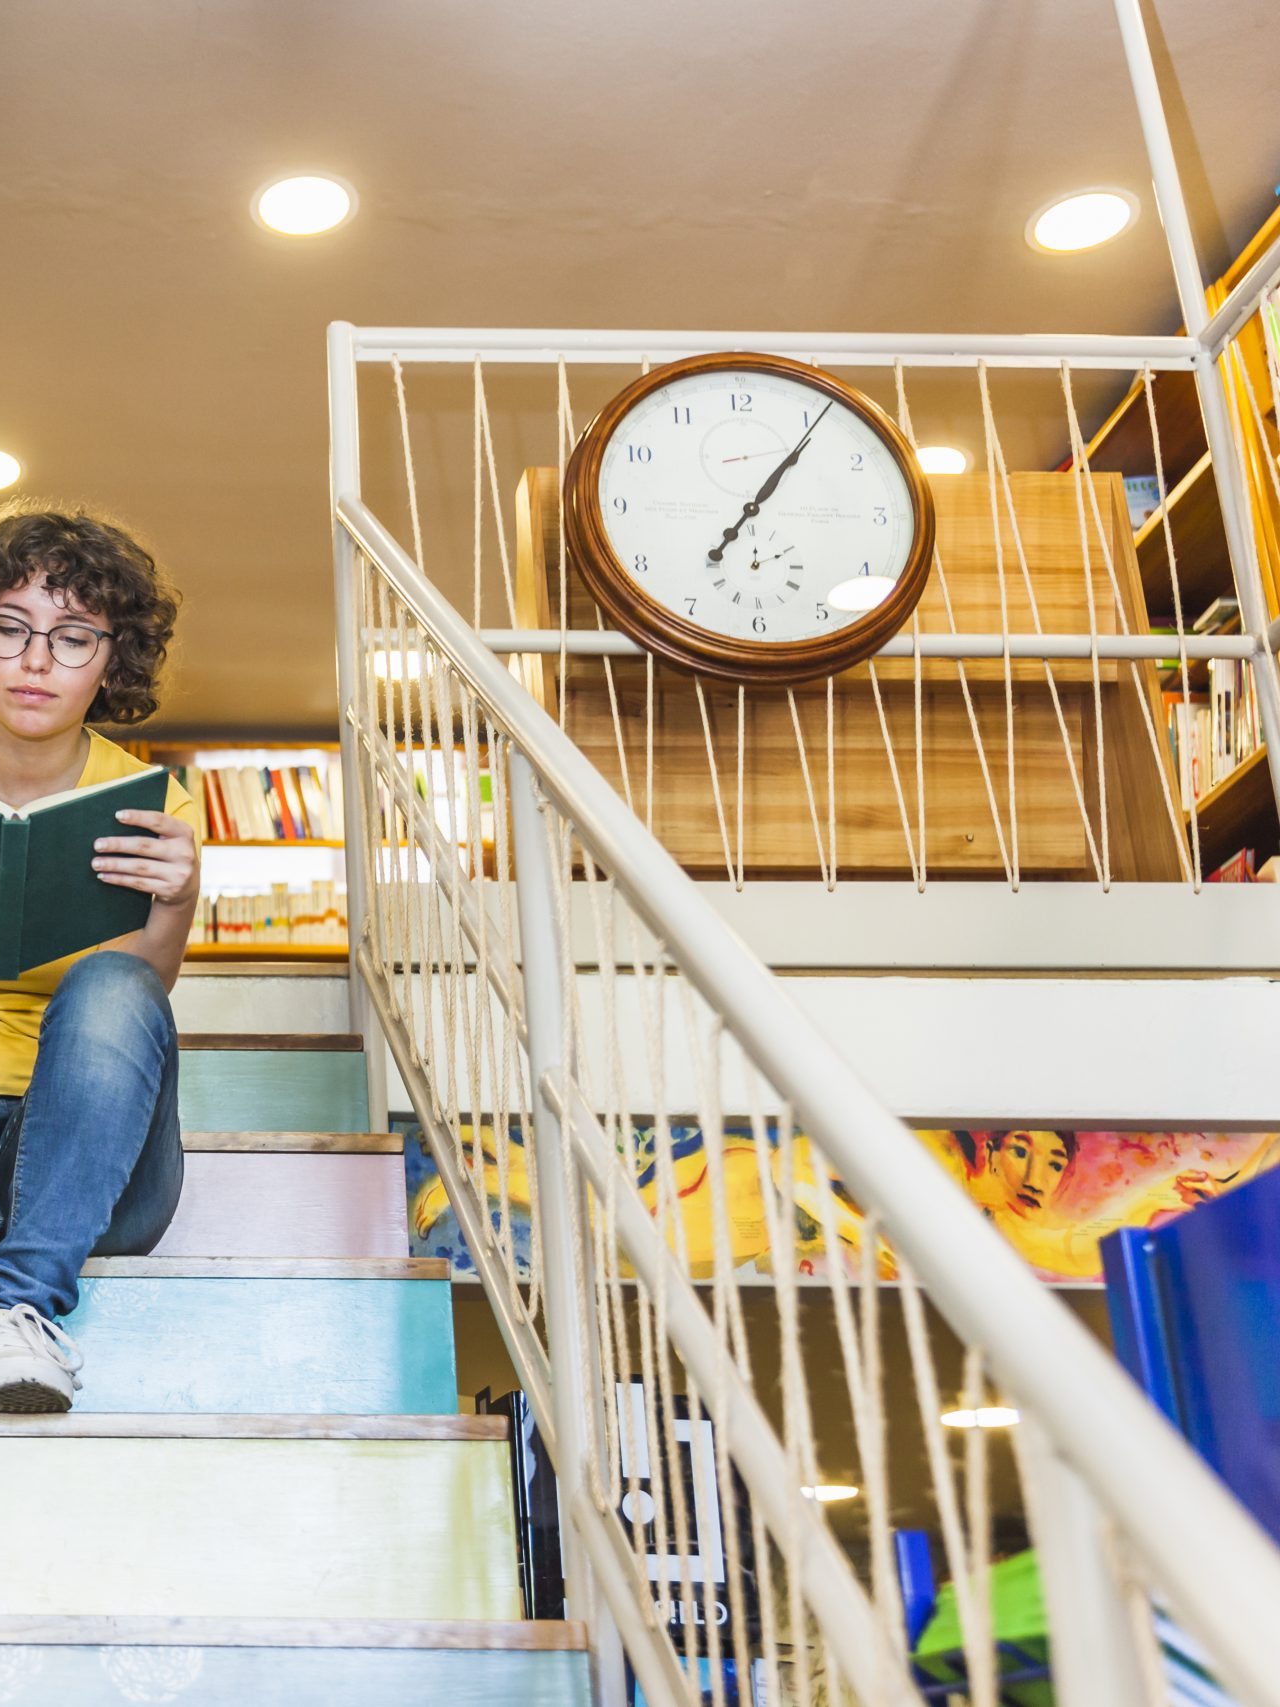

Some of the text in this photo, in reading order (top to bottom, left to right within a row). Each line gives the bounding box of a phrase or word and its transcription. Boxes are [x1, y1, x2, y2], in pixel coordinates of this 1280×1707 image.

[730, 393, 753, 412] 12
[673, 407, 691, 424] 11
[803, 410, 809, 428] 1
[628, 445, 652, 464] 10
[850, 453, 864, 471] 2
[613, 496, 627, 516] 9
[873, 506, 887, 526] 3
[634, 553, 648, 572] 8
[858, 561, 872, 577] 4
[683, 597, 697, 616] 7
[816, 602, 829, 621] 5
[752, 615, 767, 633] 6
